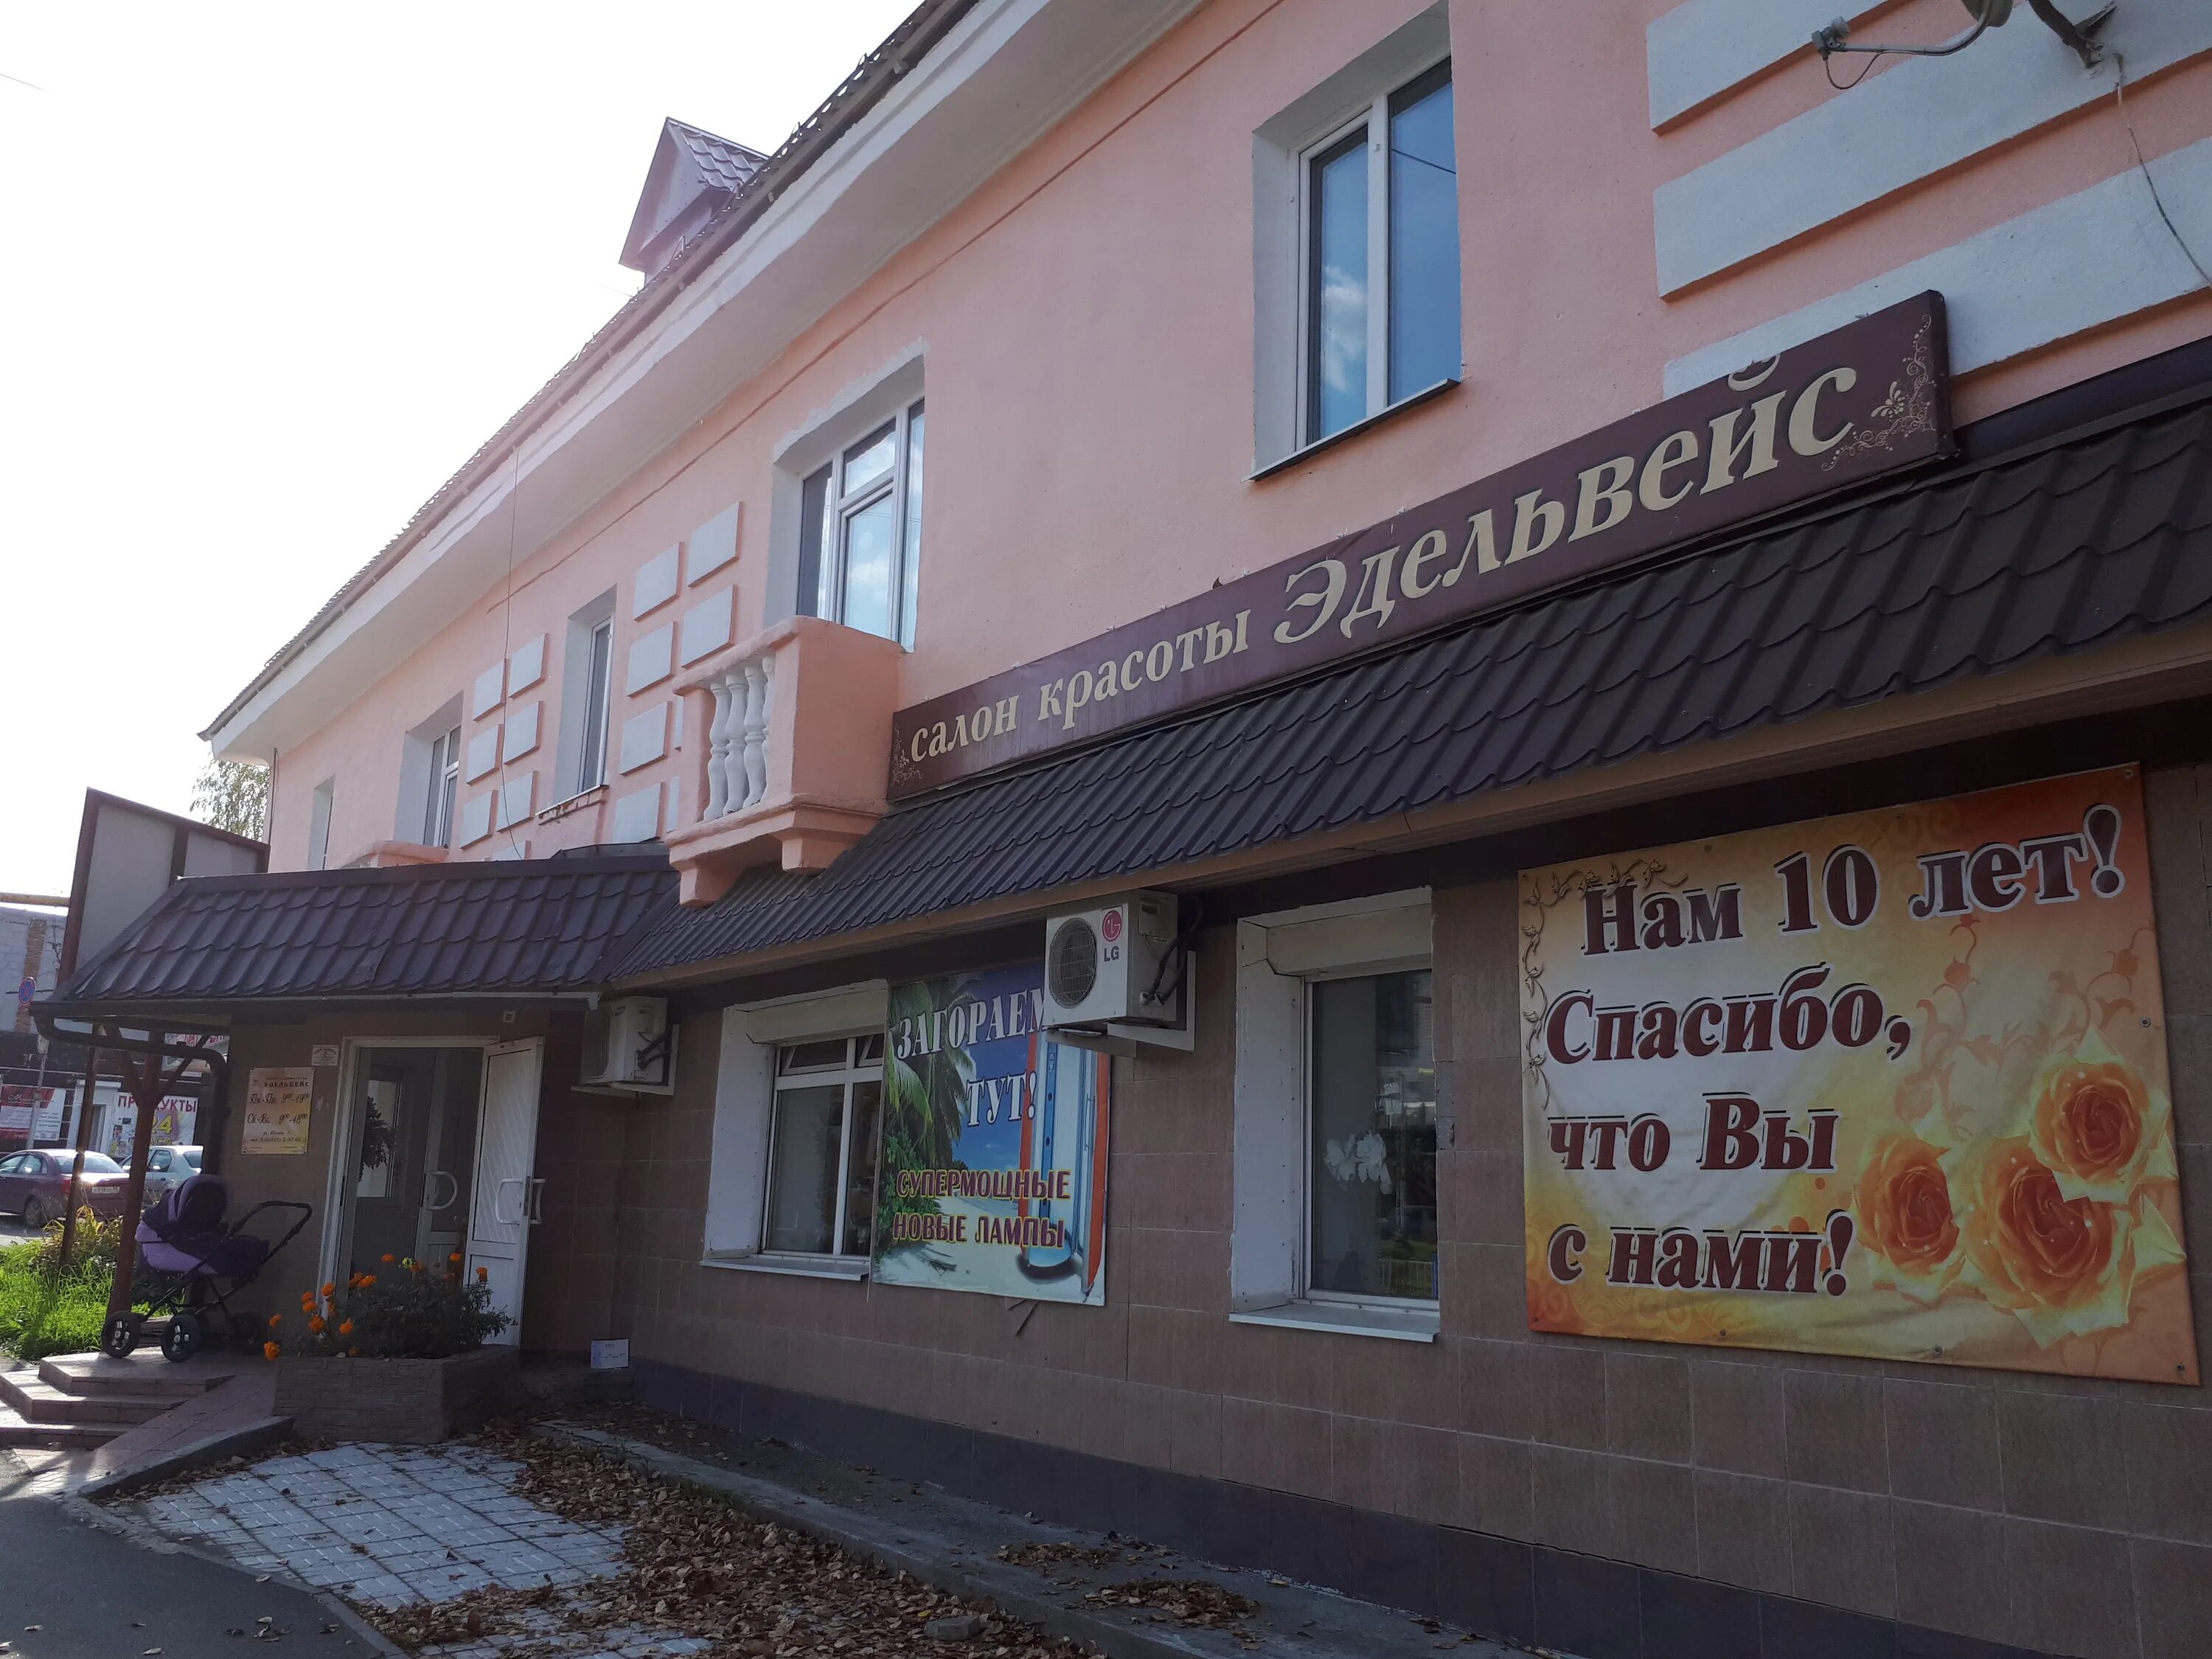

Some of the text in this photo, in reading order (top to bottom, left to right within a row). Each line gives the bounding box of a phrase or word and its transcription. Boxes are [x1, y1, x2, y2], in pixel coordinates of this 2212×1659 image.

[911, 355, 1857, 762] салон красоты Эдельвейс
[1581, 804, 2124, 956] Нам 10 лет!
[1104, 945, 1119, 961] LG
[898, 987, 1048, 1060] ЗАГОРАЕМ
[1544, 961, 1912, 1065] Спасибо,
[117, 1095, 197, 1113] ПРУКТЫ
[965, 1071, 1039, 1127] ТУТ!
[1548, 1091, 1839, 1173] что Вы
[897, 1169, 1071, 1200] СУПЕРМОЩНЫЕ
[893, 1212, 1066, 1248] НОВЫЕ ЛАМПЫ
[1547, 1208, 1856, 1297] с нами!
